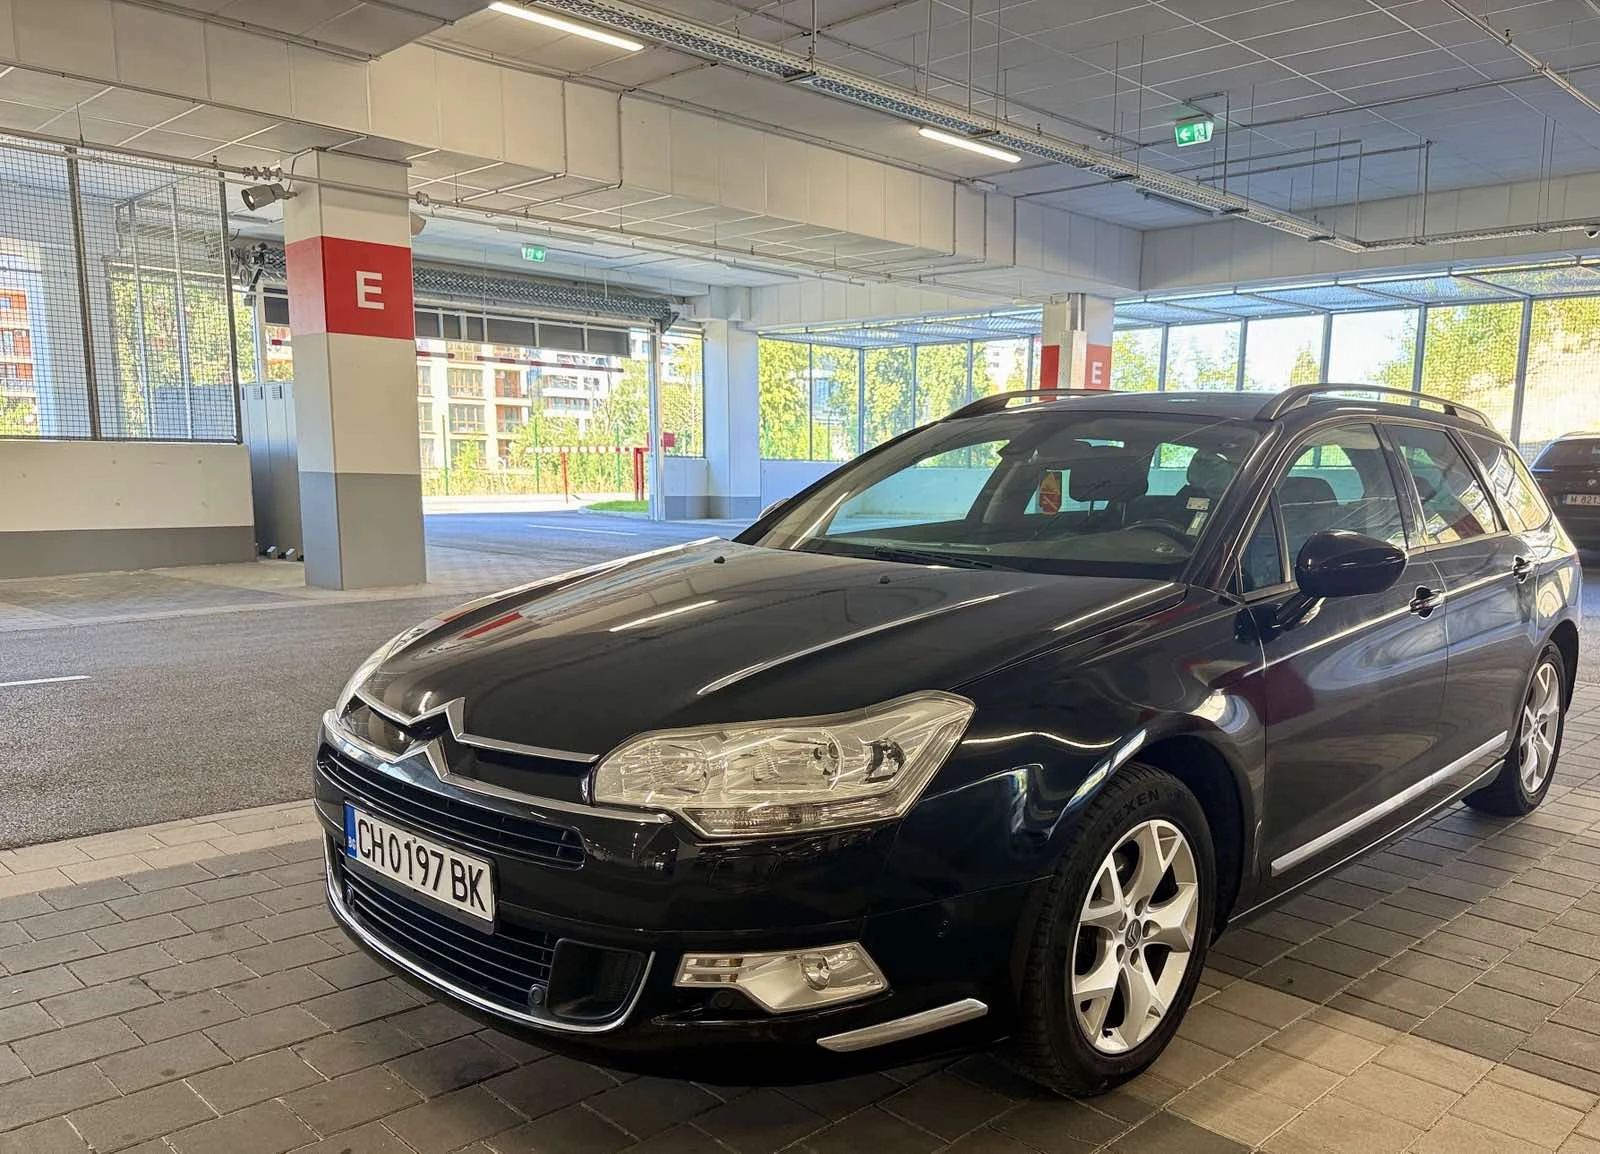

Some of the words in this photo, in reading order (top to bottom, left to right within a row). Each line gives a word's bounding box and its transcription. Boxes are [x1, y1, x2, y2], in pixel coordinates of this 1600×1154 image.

[355, 270, 385, 310] E
[1091, 361, 1103, 385] E
[450, 857, 487, 913] BK
